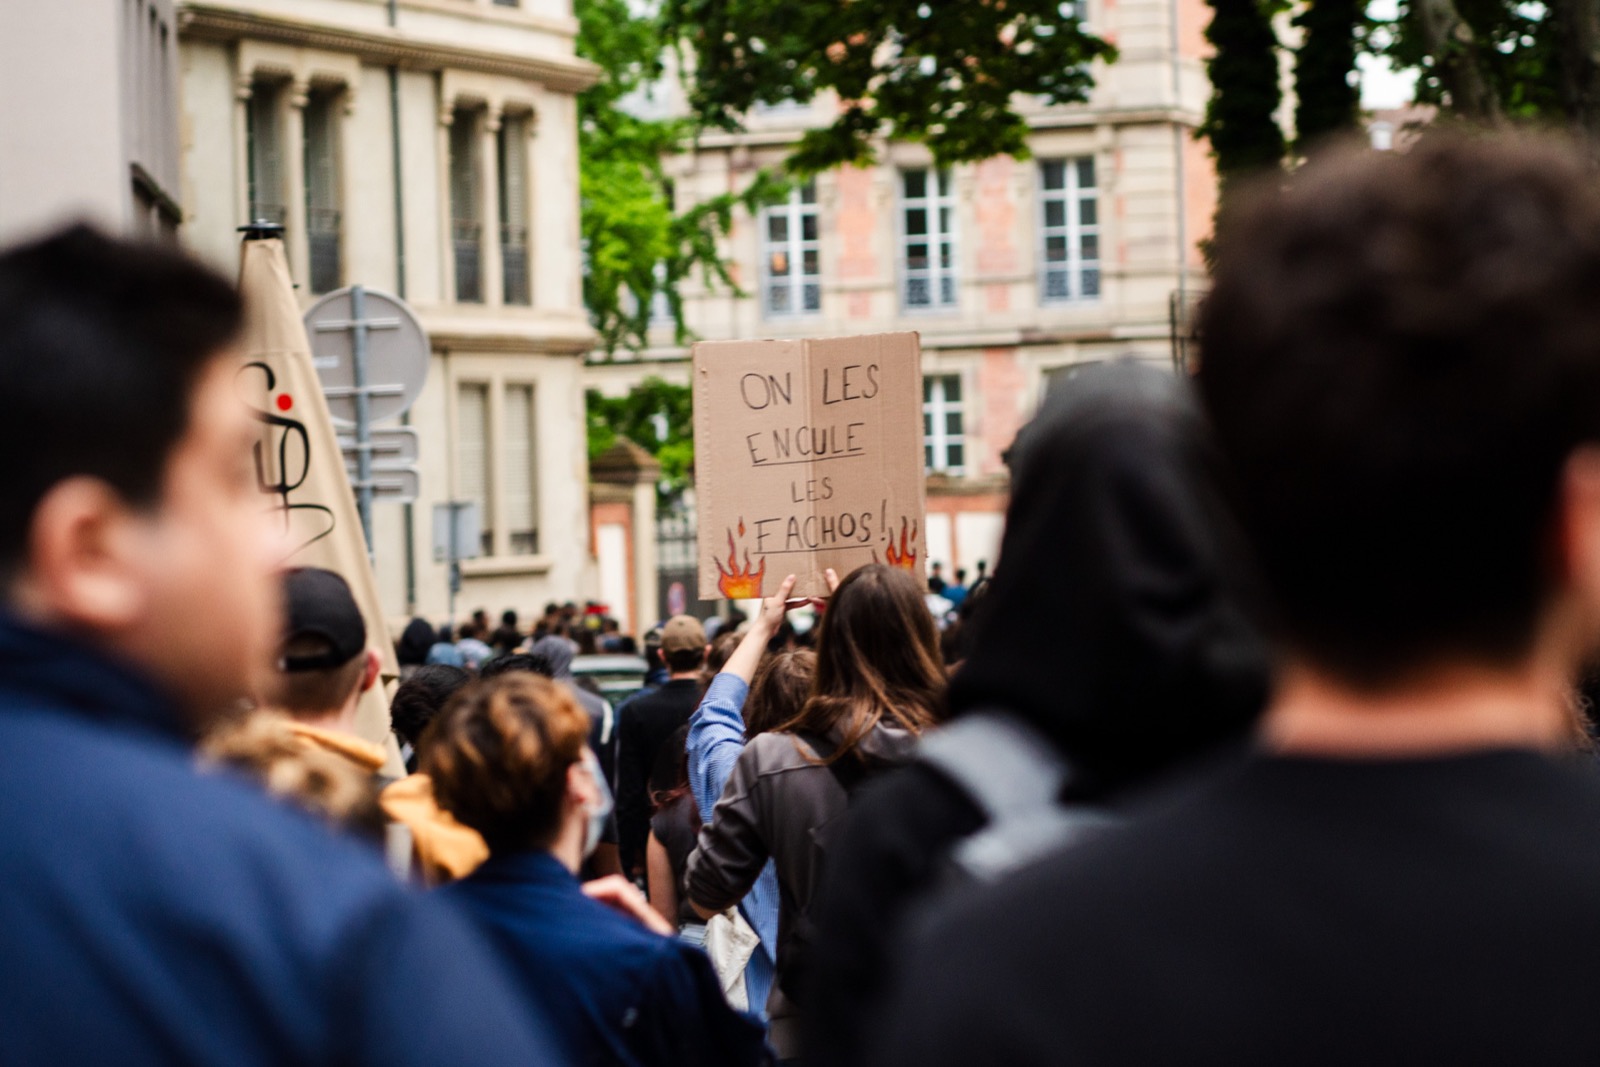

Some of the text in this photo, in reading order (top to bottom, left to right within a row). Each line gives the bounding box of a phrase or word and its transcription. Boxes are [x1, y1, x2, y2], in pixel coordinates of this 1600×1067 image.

[740, 363, 880, 410] ON LES
[746, 422, 866, 464] ENCULE
[791, 476, 834, 503] LES
